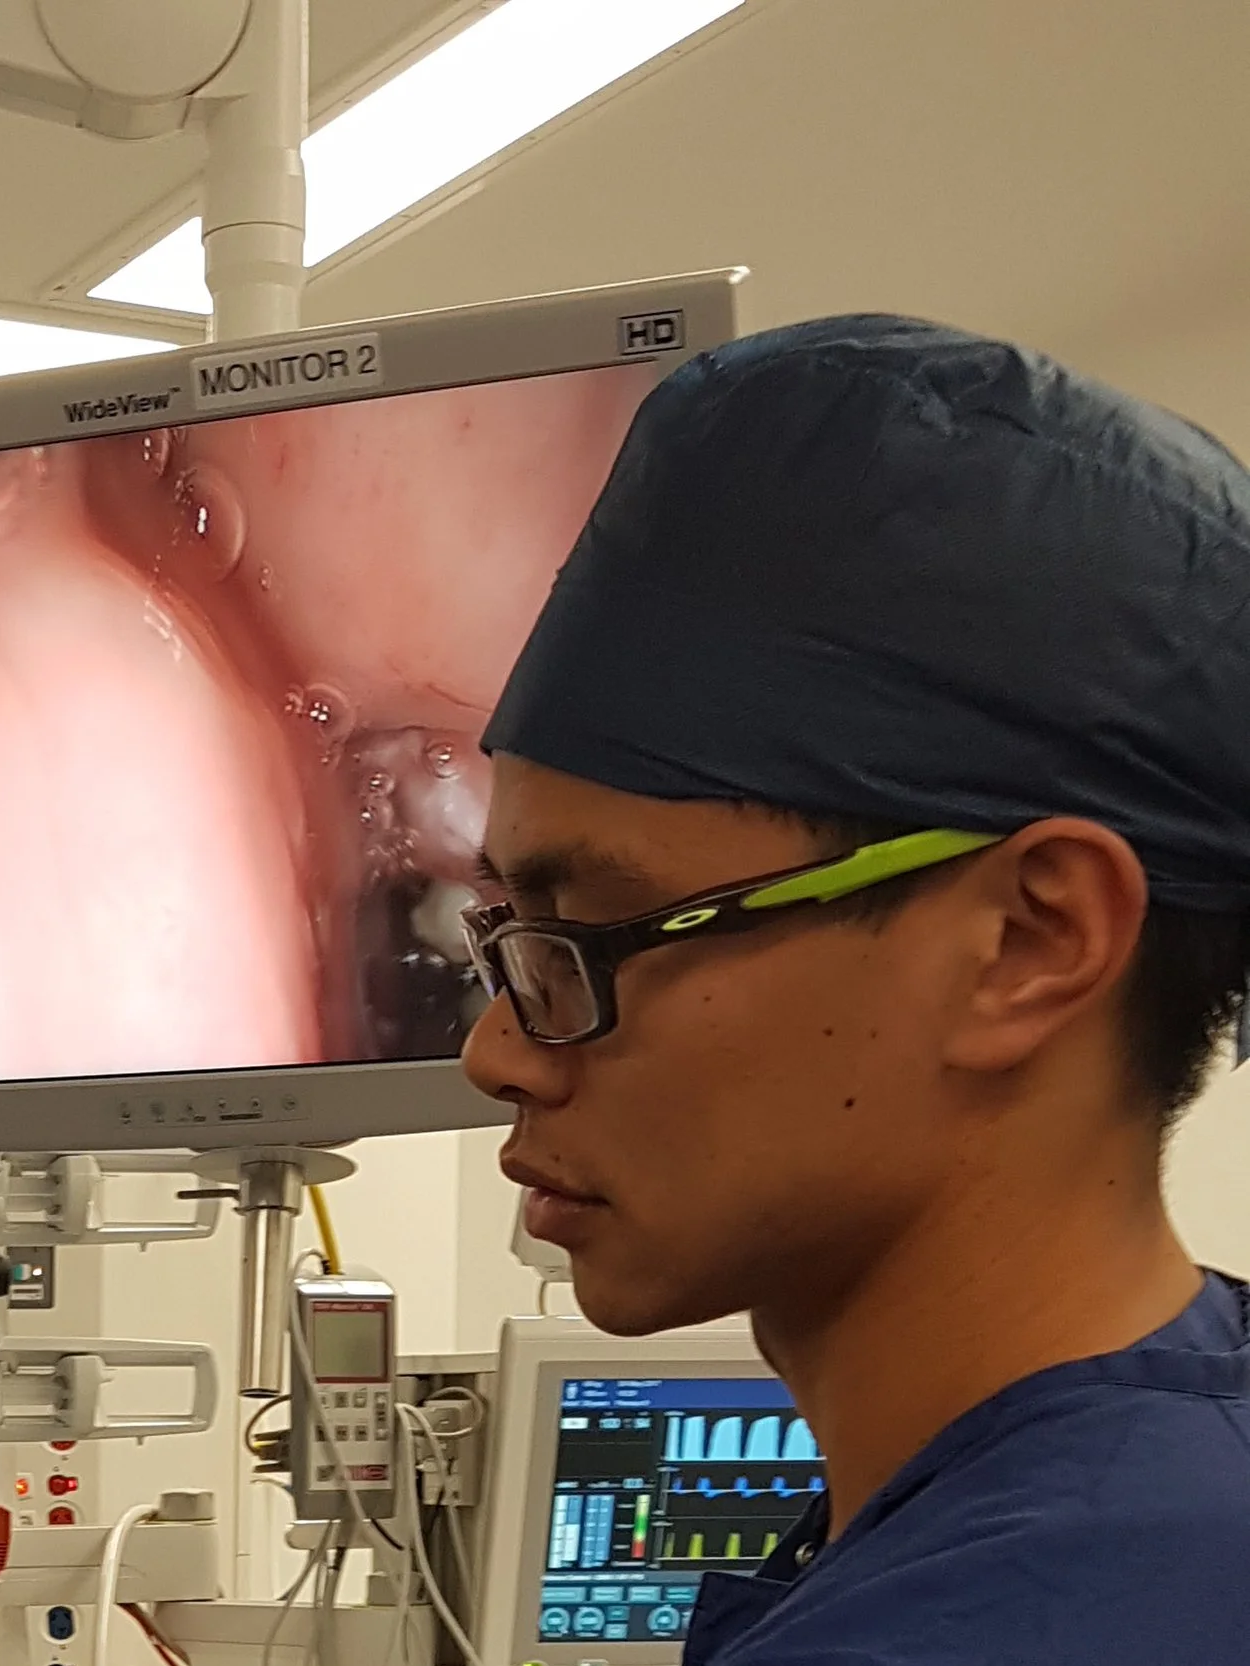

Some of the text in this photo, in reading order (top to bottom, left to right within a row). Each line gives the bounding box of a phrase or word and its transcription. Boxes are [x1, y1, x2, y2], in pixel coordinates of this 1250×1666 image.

[626, 318, 675, 348] HD
[199, 344, 377, 398] MONITOR 2
